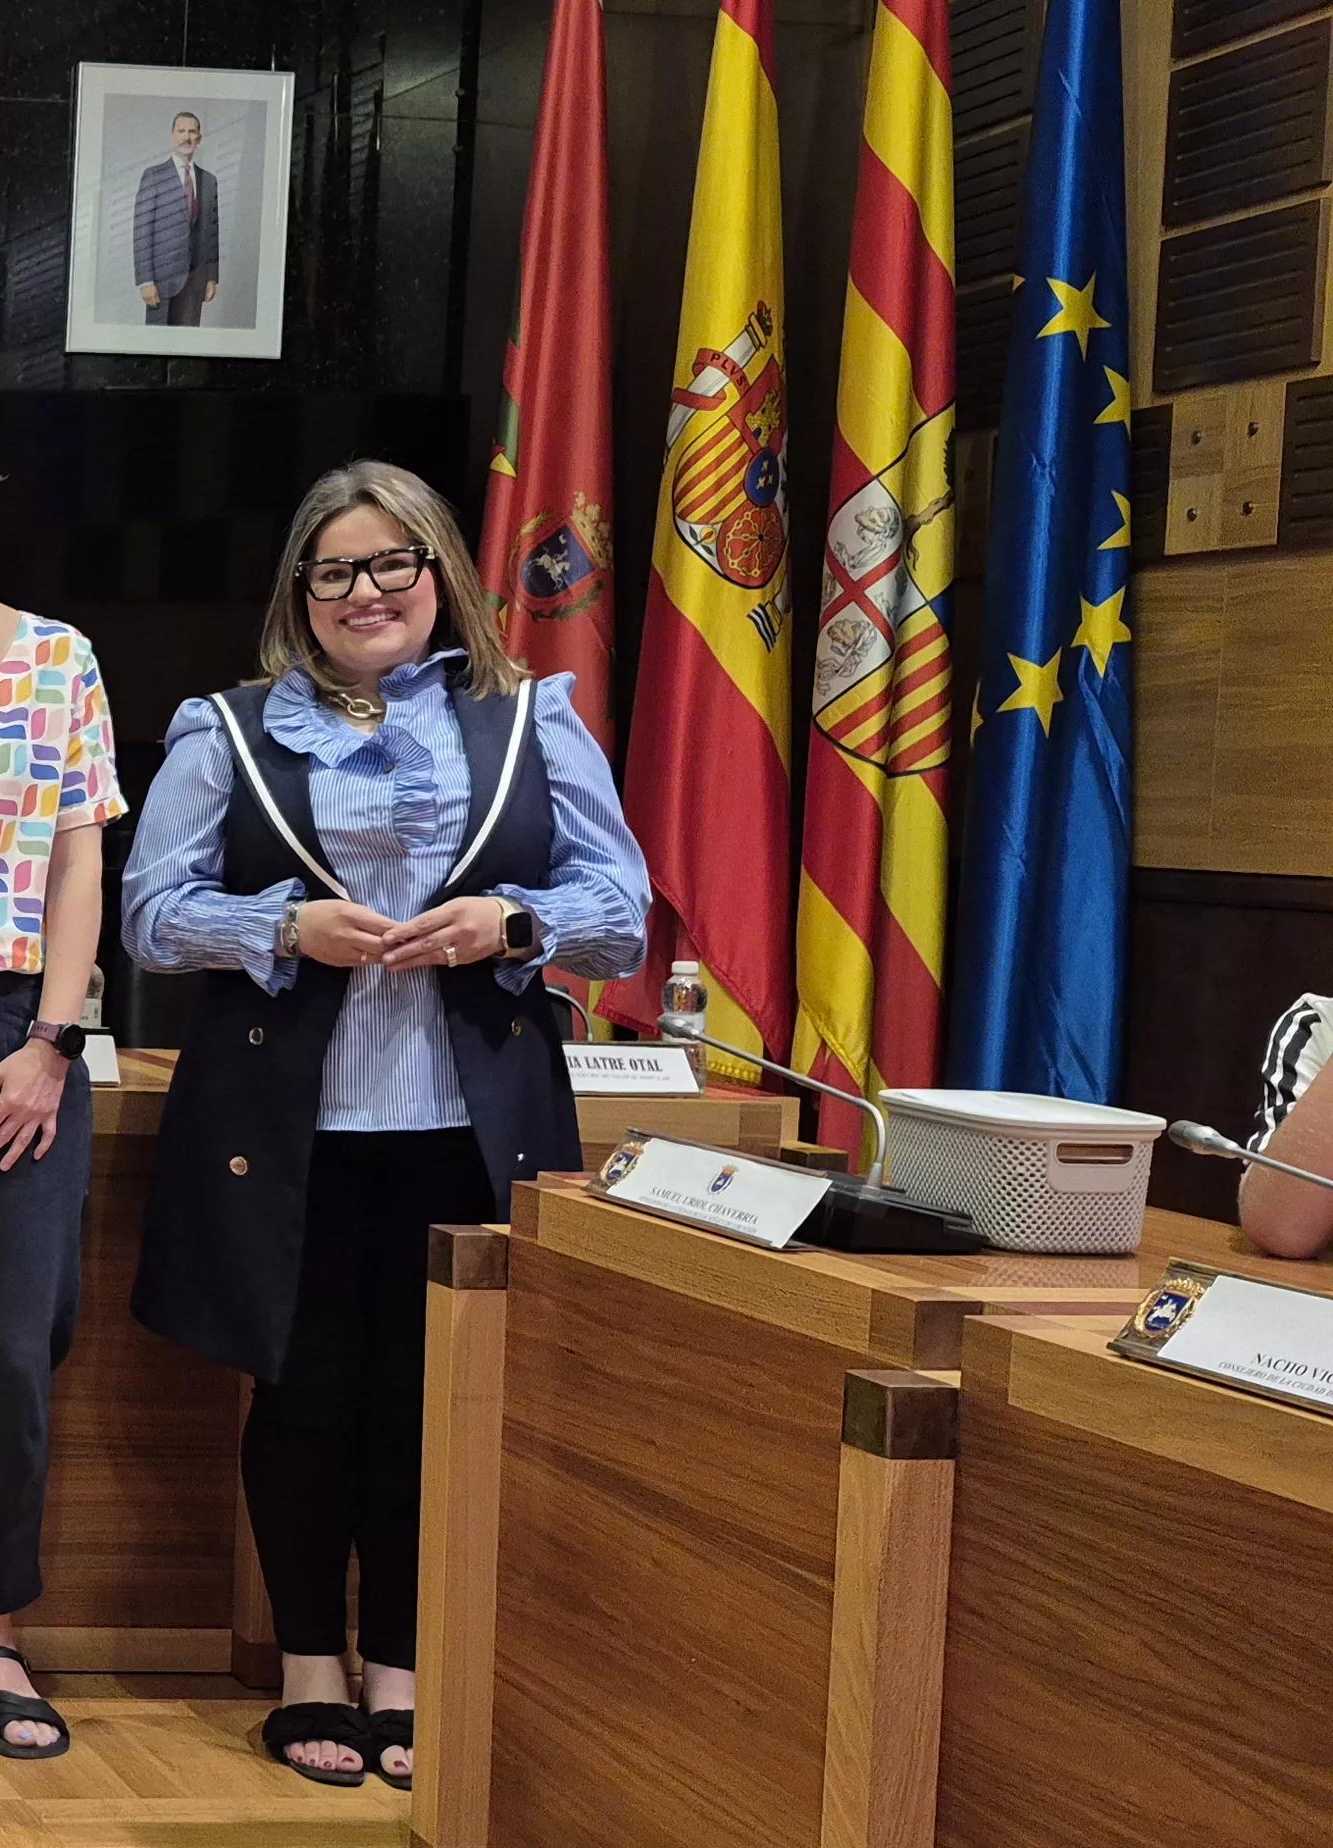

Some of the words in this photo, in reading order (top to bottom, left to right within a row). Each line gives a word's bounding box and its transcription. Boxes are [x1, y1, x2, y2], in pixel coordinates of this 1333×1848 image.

[710, 352, 746, 386] PLVS
[567, 1055, 582, 1069] IA
[584, 1056, 627, 1071] LATRE
[629, 1058, 663, 1072] OTAL
[650, 1187, 682, 1202] SAMUEL
[1218, 1361, 1267, 1379] CONSEJERO
[1251, 1352, 1308, 1377] NACHO
